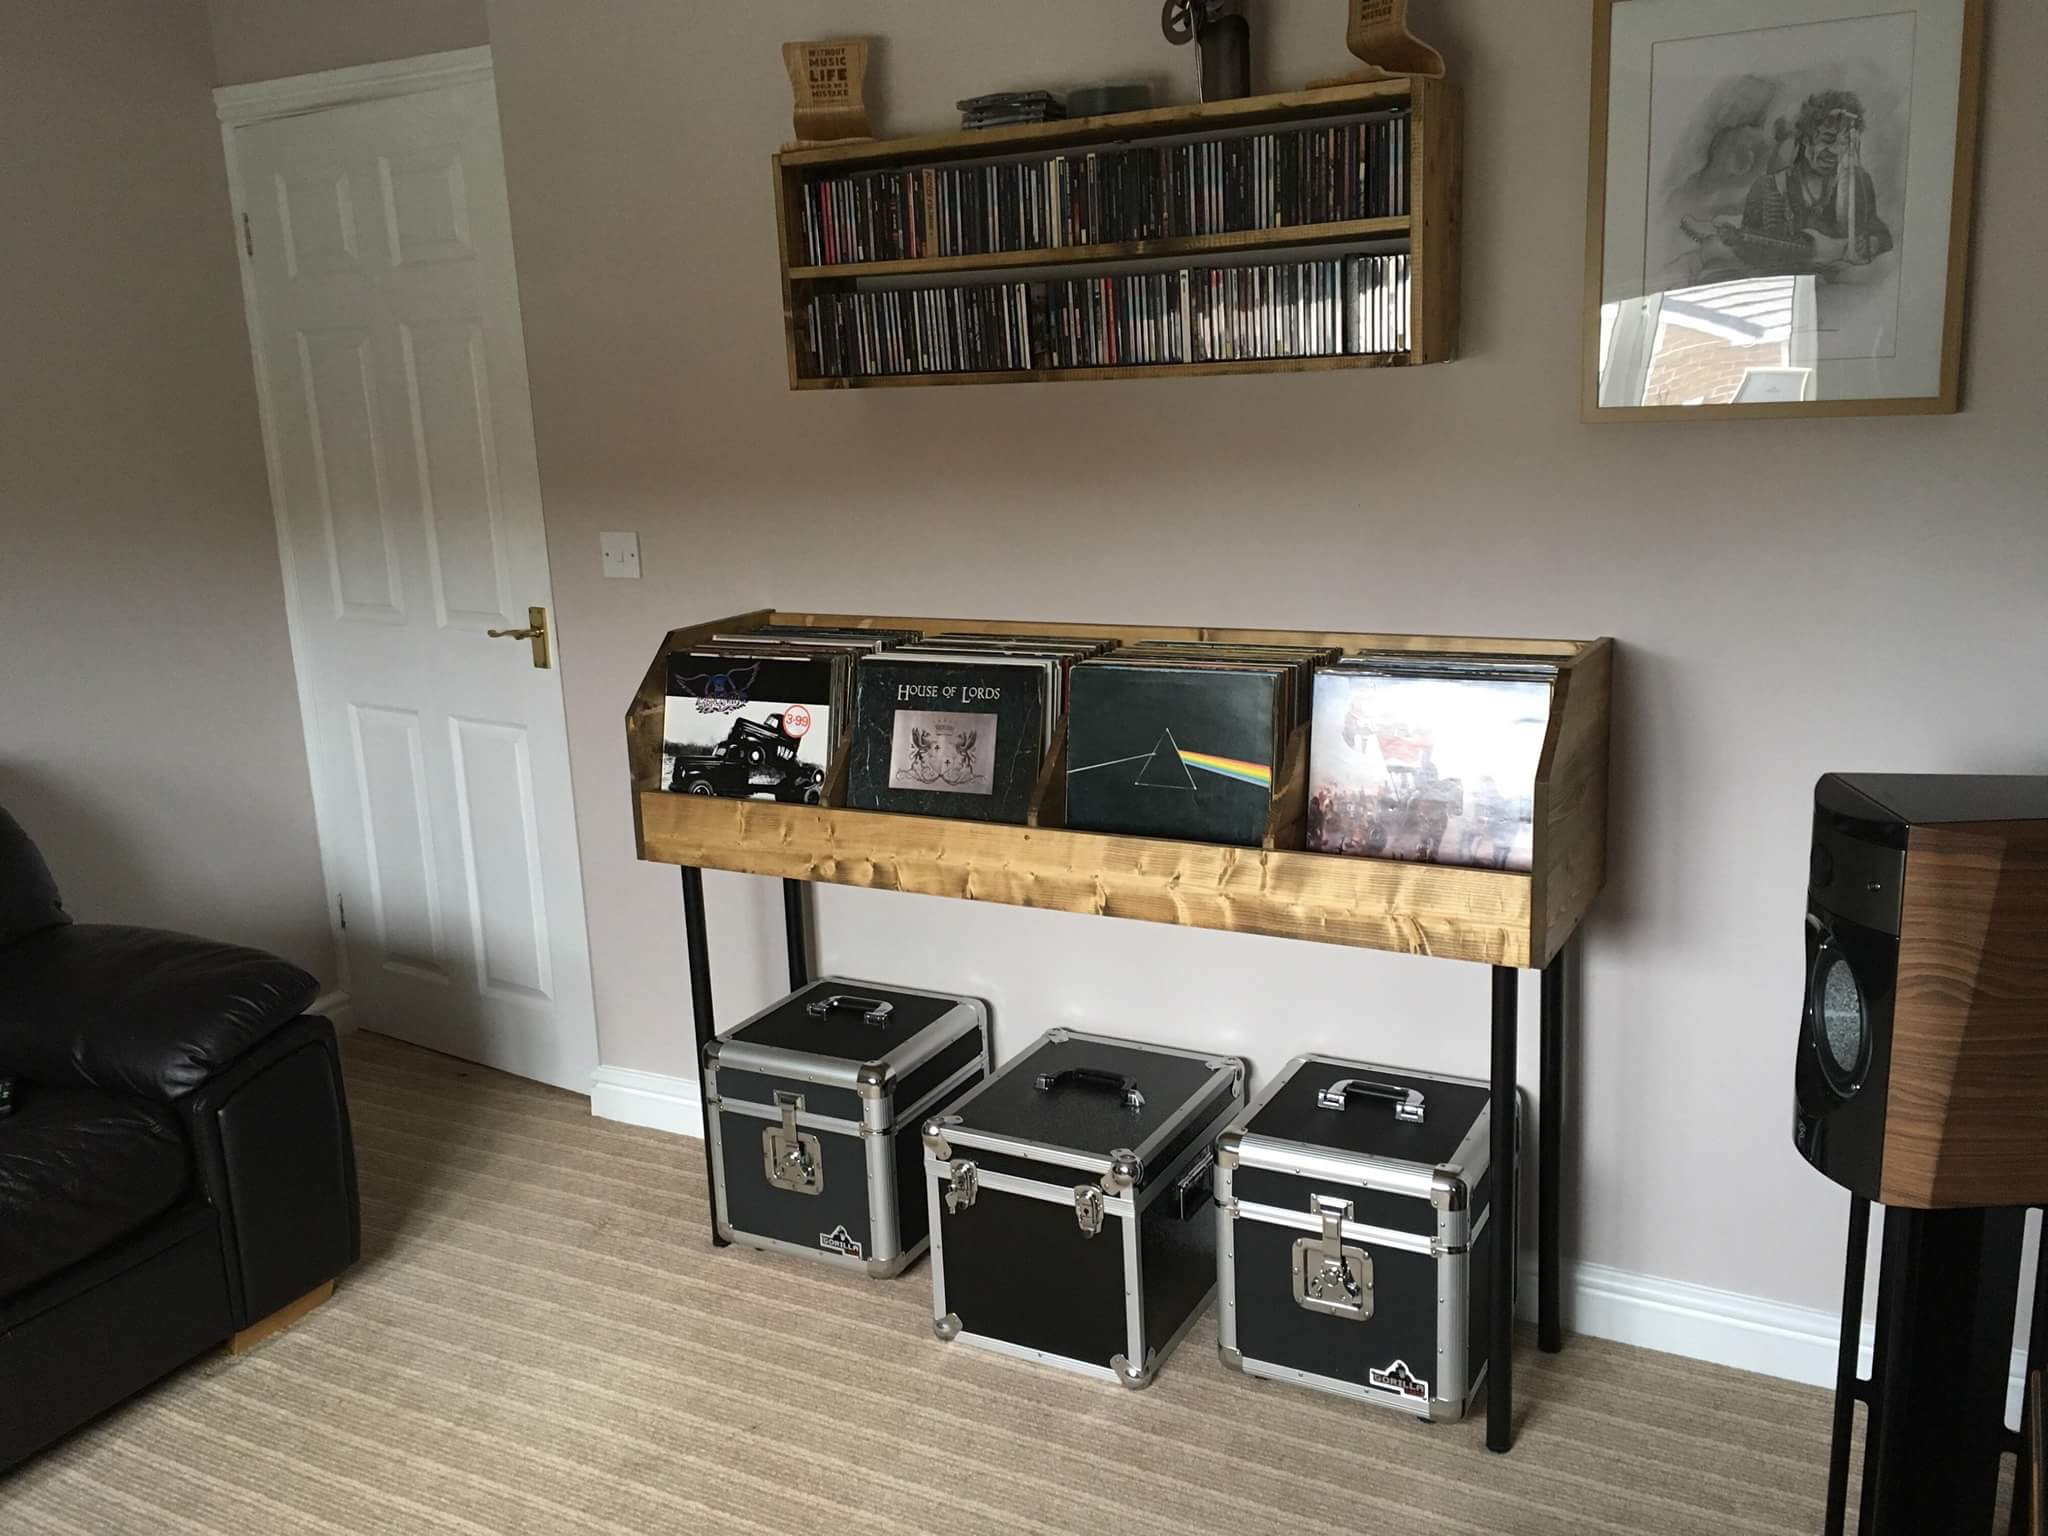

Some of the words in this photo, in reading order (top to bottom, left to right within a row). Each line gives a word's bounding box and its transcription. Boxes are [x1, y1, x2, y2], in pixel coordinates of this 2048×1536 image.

[808, 48, 845, 56] WITHOUT
[809, 56, 846, 67] MUSIC
[810, 69, 847, 82] LIFE
[811, 89, 848, 97] MISTAKE
[942, 686, 957, 699] OF
[823, 1237, 859, 1252] GORILLA
[1374, 1374, 1425, 1392] GORILLA
